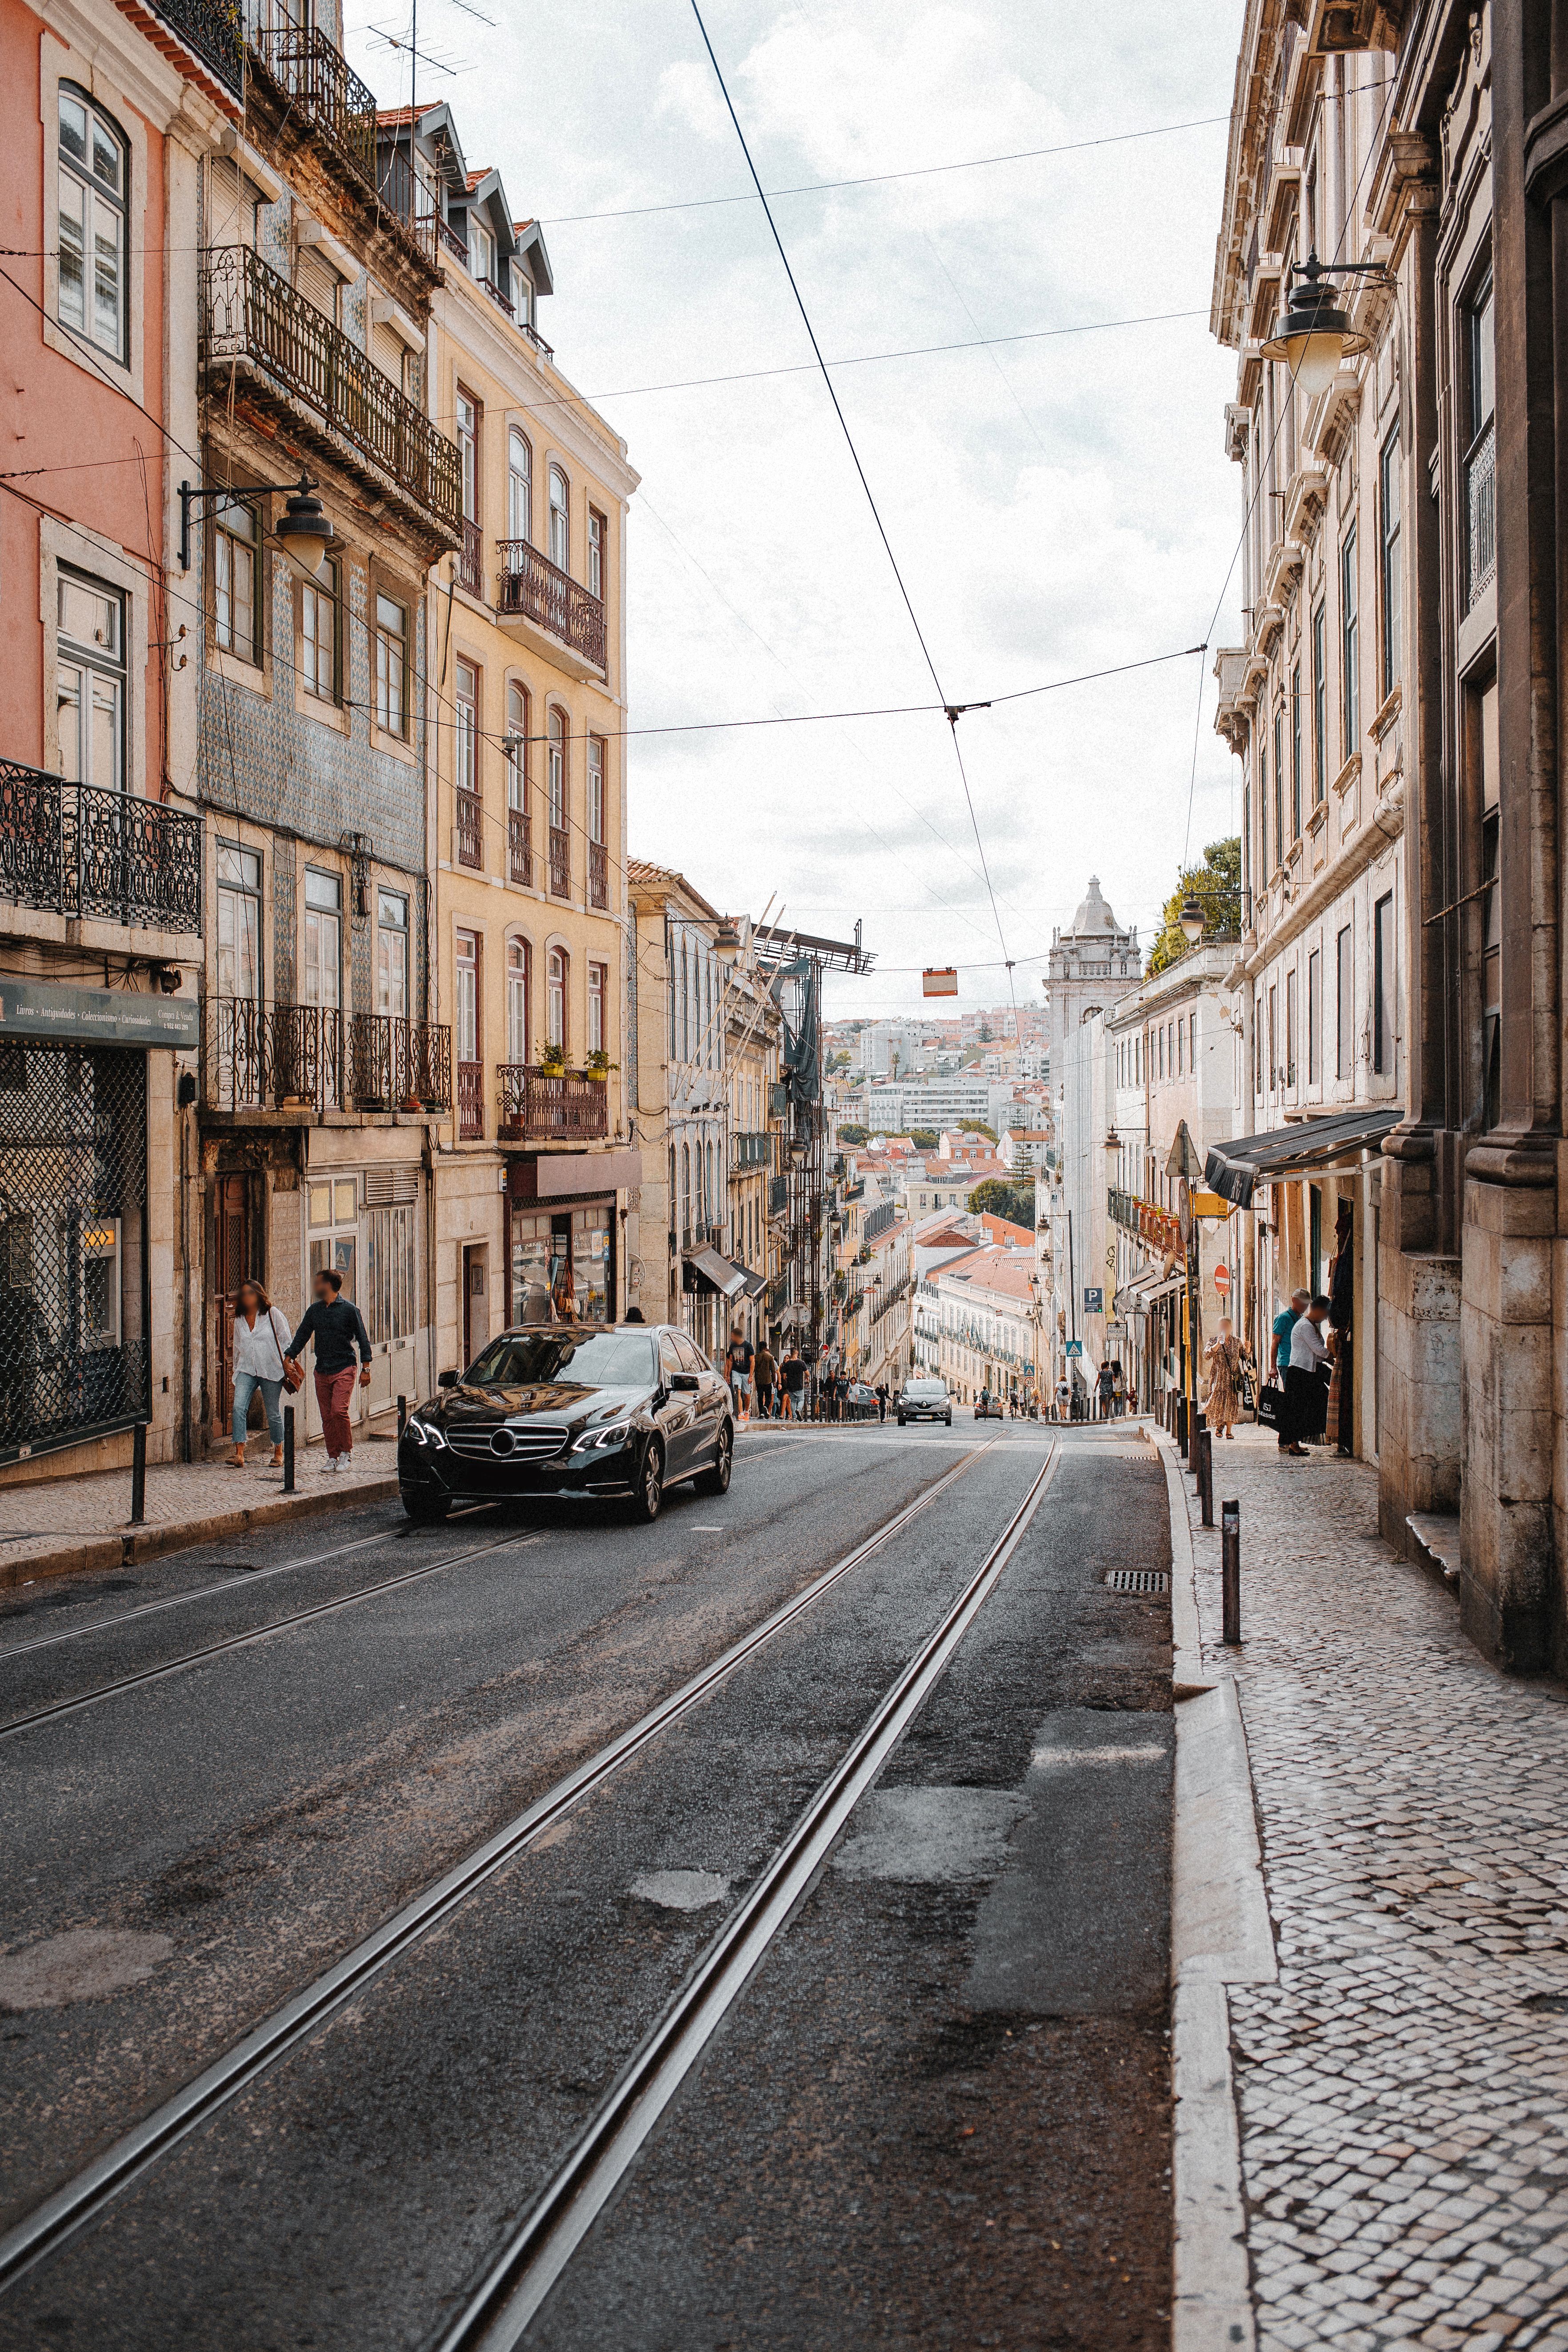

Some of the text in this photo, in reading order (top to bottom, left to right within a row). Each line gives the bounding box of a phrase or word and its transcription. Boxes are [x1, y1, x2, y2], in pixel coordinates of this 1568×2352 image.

[16, 1004, 152, 1026] Livros Antiguidades Coleccionismo Curiosidades
[158, 1009, 193, 1021] Compra & Venda
[1088, 1290, 1098, 1301] P
[1244, 1376, 1253, 1404] fnac
[1258, 1410, 1276, 1420] SEASIDE
